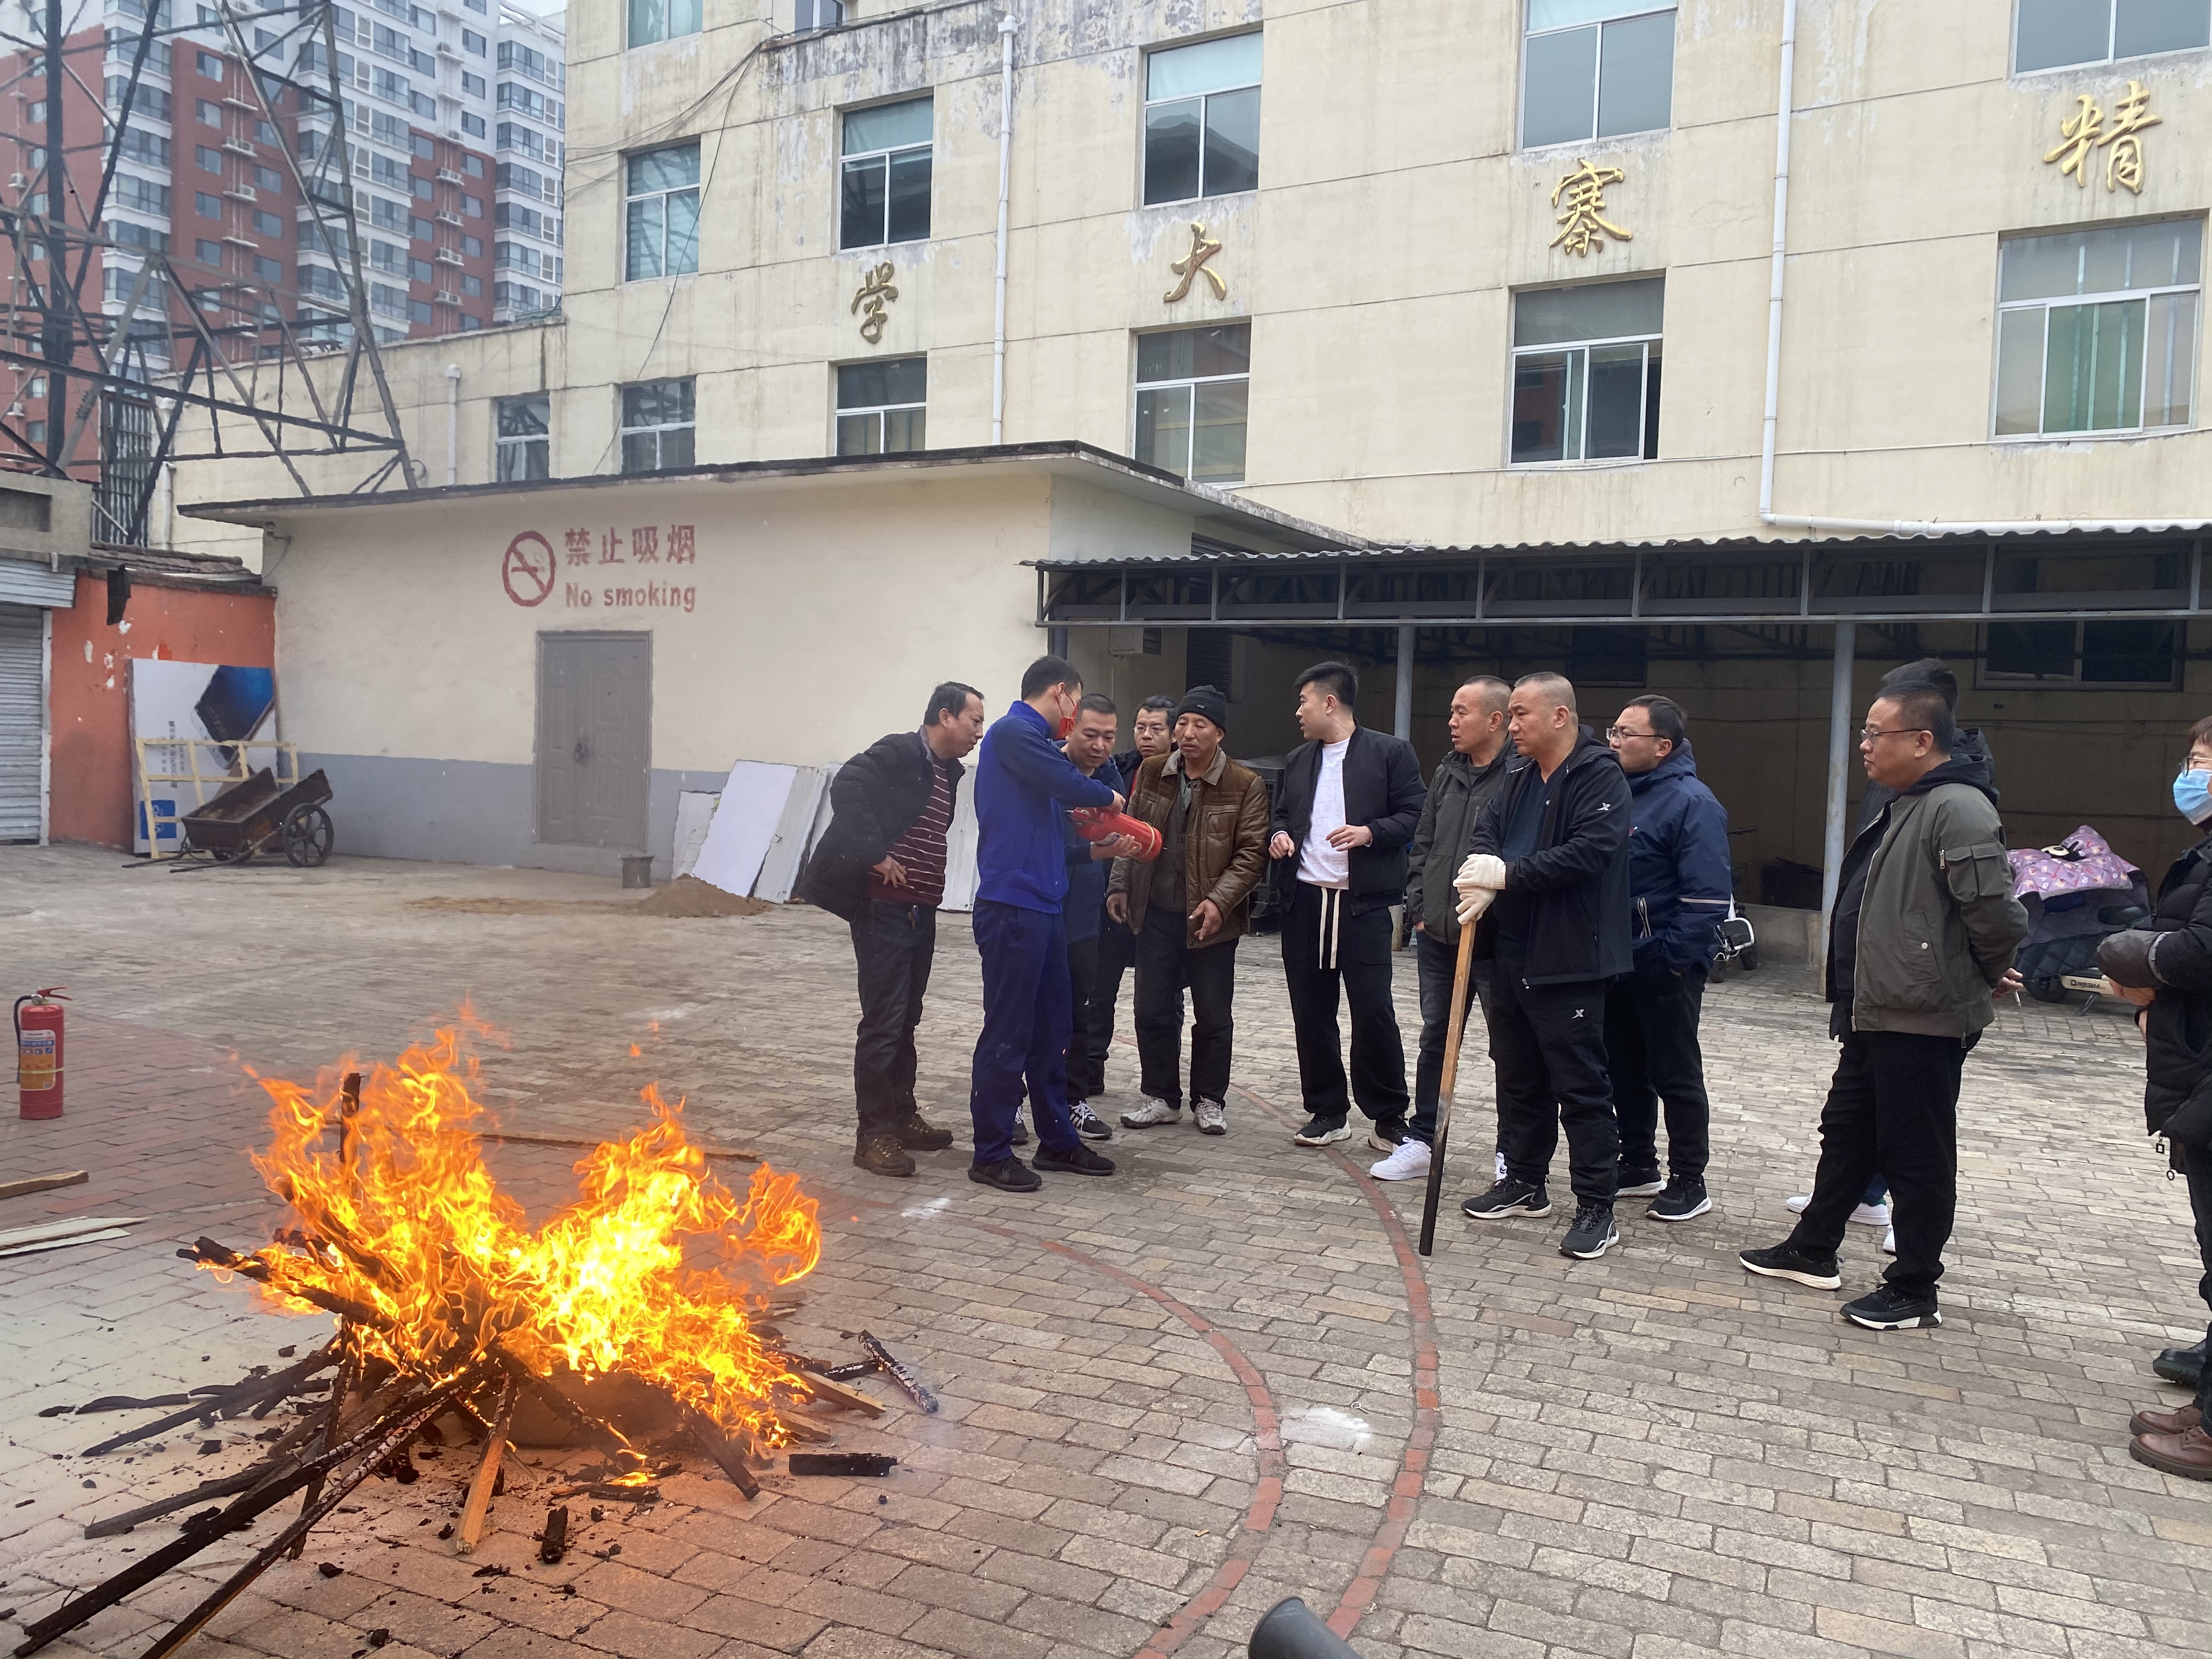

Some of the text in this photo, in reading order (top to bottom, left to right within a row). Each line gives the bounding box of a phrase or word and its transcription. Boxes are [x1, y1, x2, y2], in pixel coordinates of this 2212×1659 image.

[565, 524, 695, 567] 禁止吸烟
[566, 579, 696, 613] No smoking
